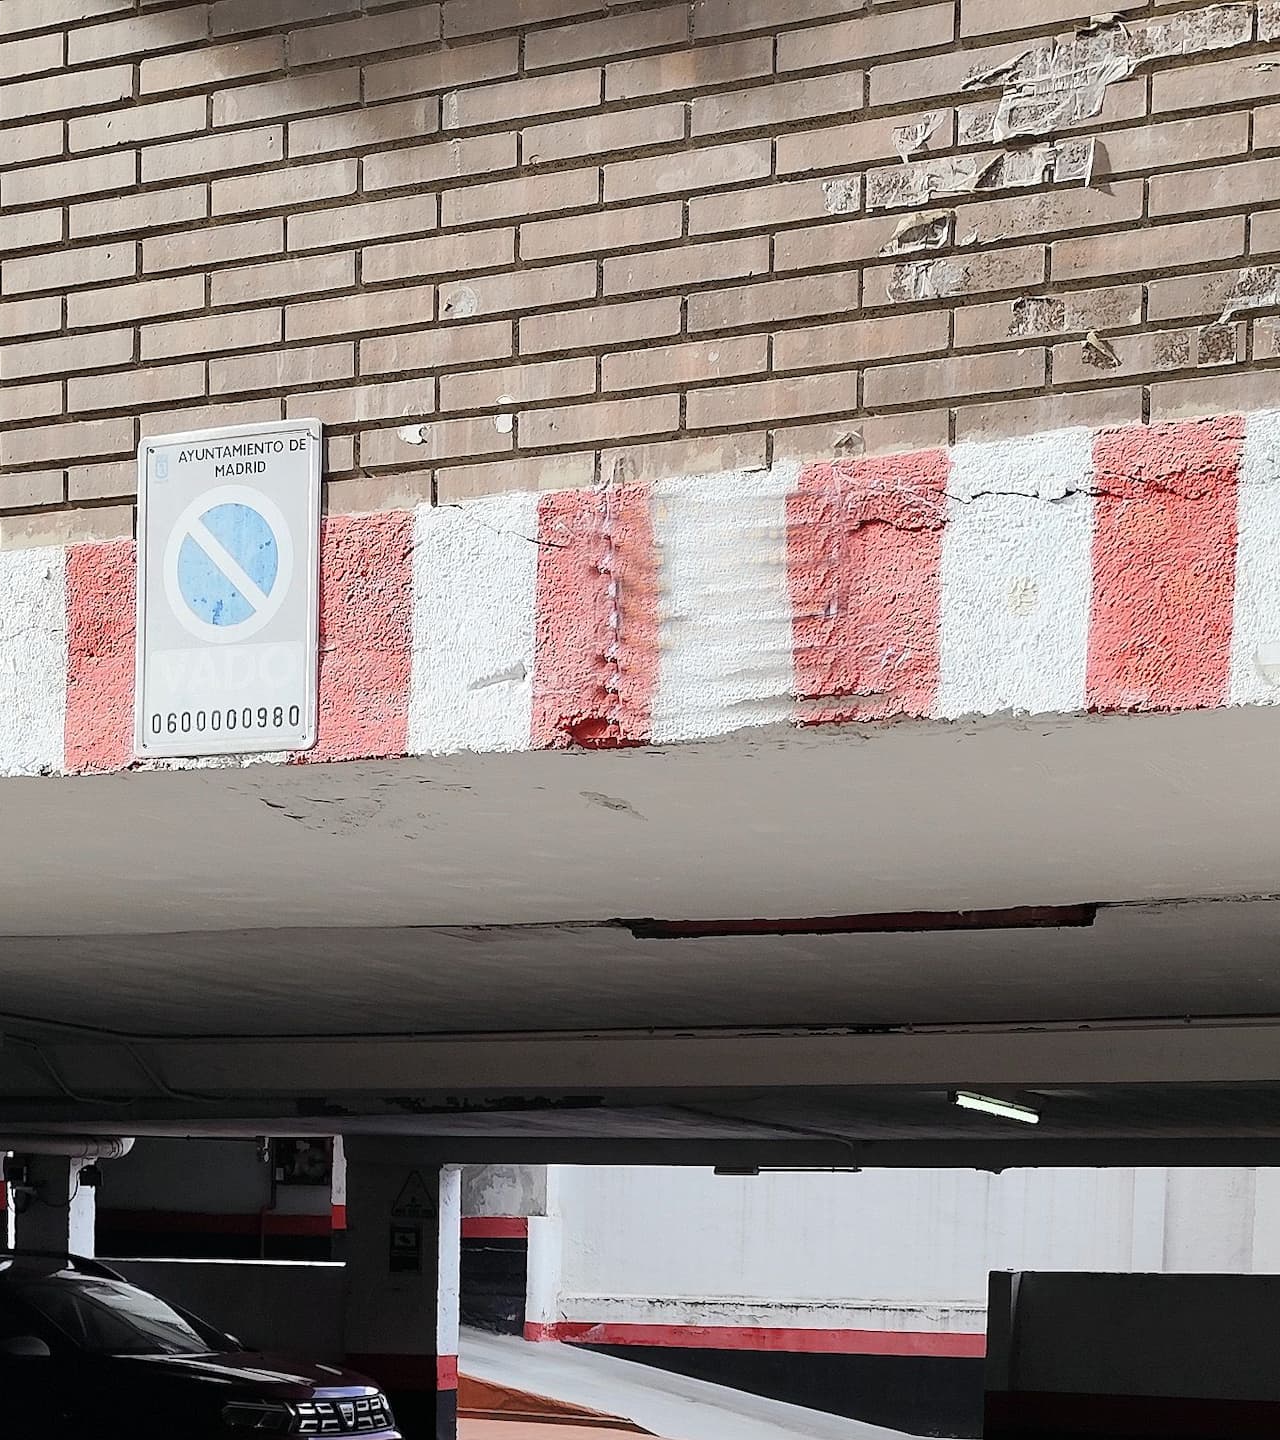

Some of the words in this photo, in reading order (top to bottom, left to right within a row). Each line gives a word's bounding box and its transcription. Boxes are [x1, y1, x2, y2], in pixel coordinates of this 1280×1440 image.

[178, 440, 284, 463] AYUNTAMIENTO
[289, 438, 307, 452] DE
[215, 460, 266, 478] MADRID
[151, 704, 300, 734] 0600000980
